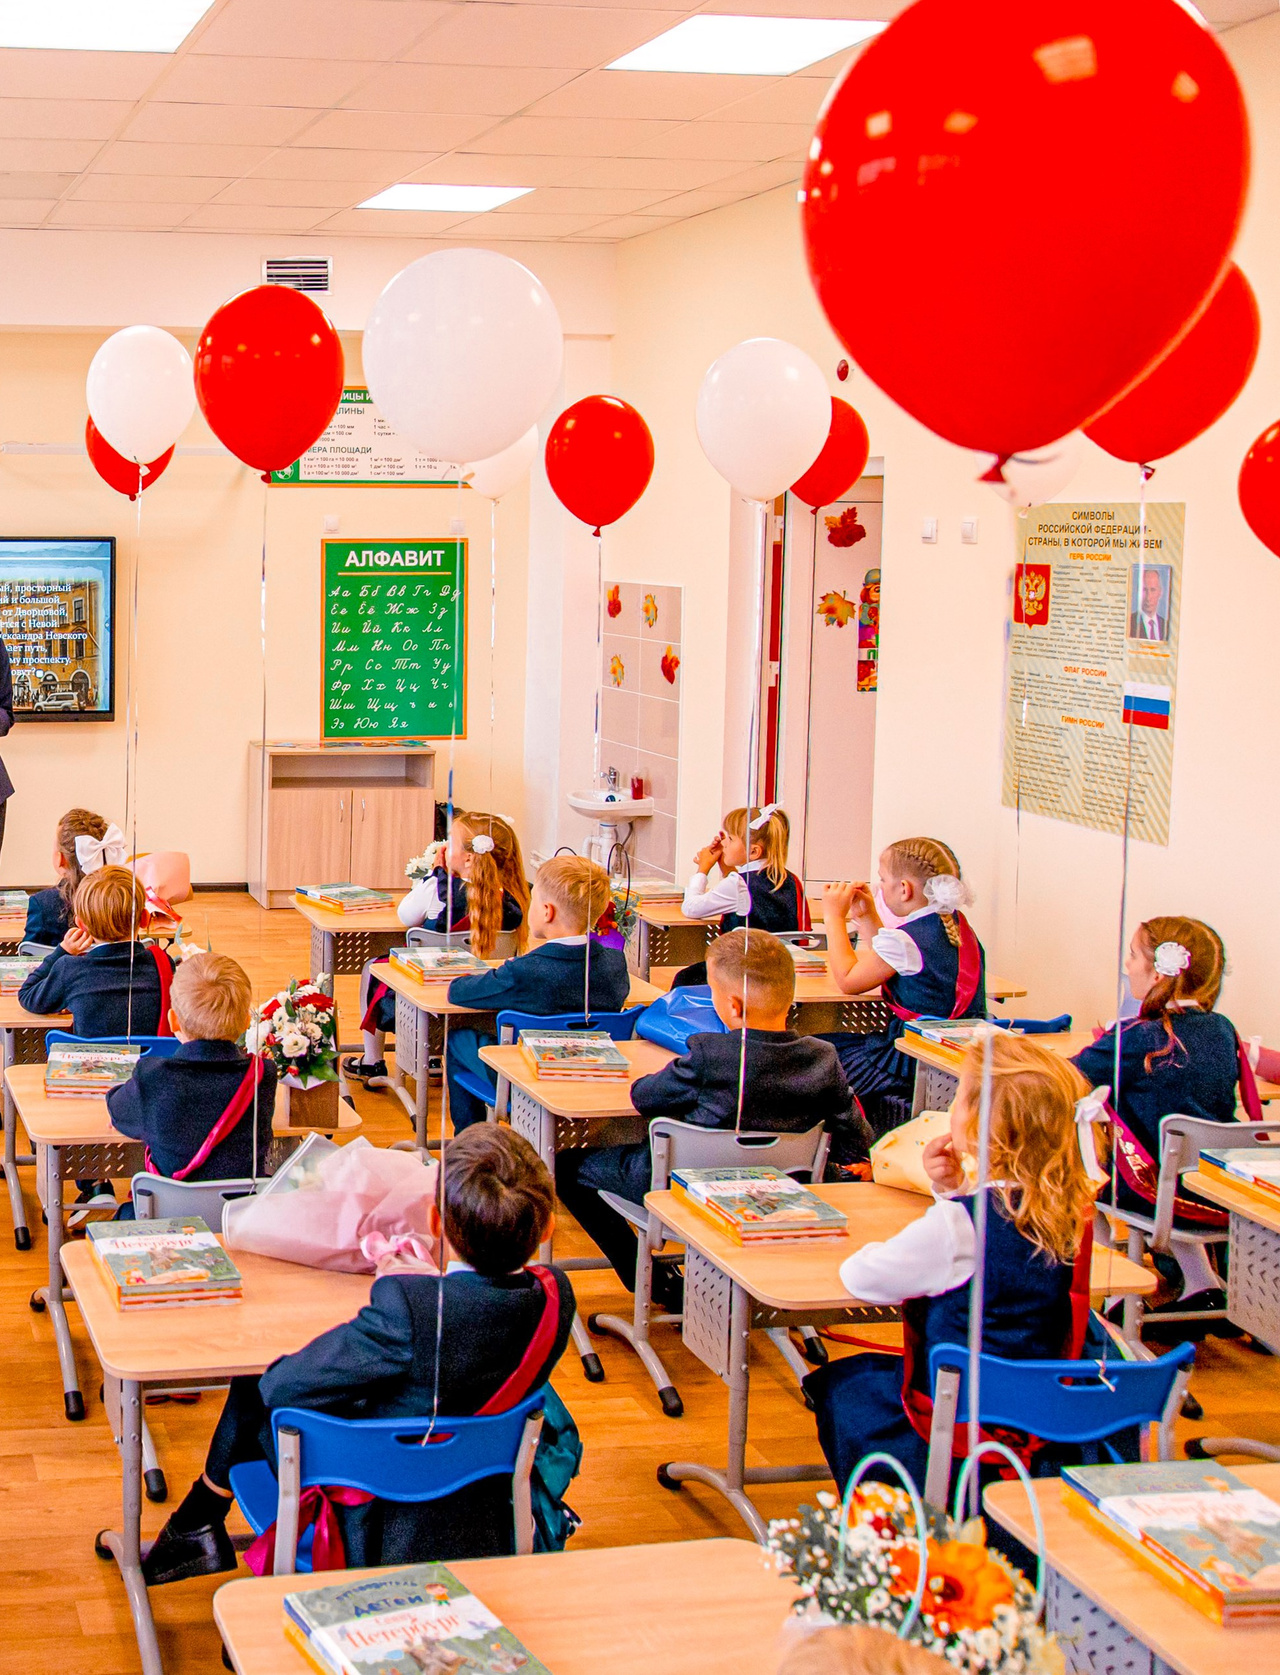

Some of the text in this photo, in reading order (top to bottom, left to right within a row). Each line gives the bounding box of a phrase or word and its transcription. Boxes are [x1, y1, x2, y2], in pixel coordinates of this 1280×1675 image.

[1072, 511, 1115, 521] СИМВОЛЫ
[1038, 522, 1093, 533] РОССИЙСКОЙ
[1028, 537, 1062, 547] СТРАНЫ,
[1064, 538, 1069, 546] В
[1071, 537, 1111, 547] КОТОРОЙ
[1112, 539, 1127, 548] МЫ
[345, 550, 445, 567] АЛФАВИТ
[1086, 553, 1112, 561] РОССИИ
[15, 584, 71, 593] просторный
[20, 595, 60, 604] большой
[15, 608, 68, 618] Дворцовой,
[29, 620, 60, 628] Невой.
[46, 632, 88, 640] Невского
[23, 657, 71, 666] проспекту.
[11, 668, 36, 676] овут?
[1063, 665, 1107, 678] ФЛАГ РОССИИ
[1061, 715, 1105, 729] ГИМН РОССИИ
